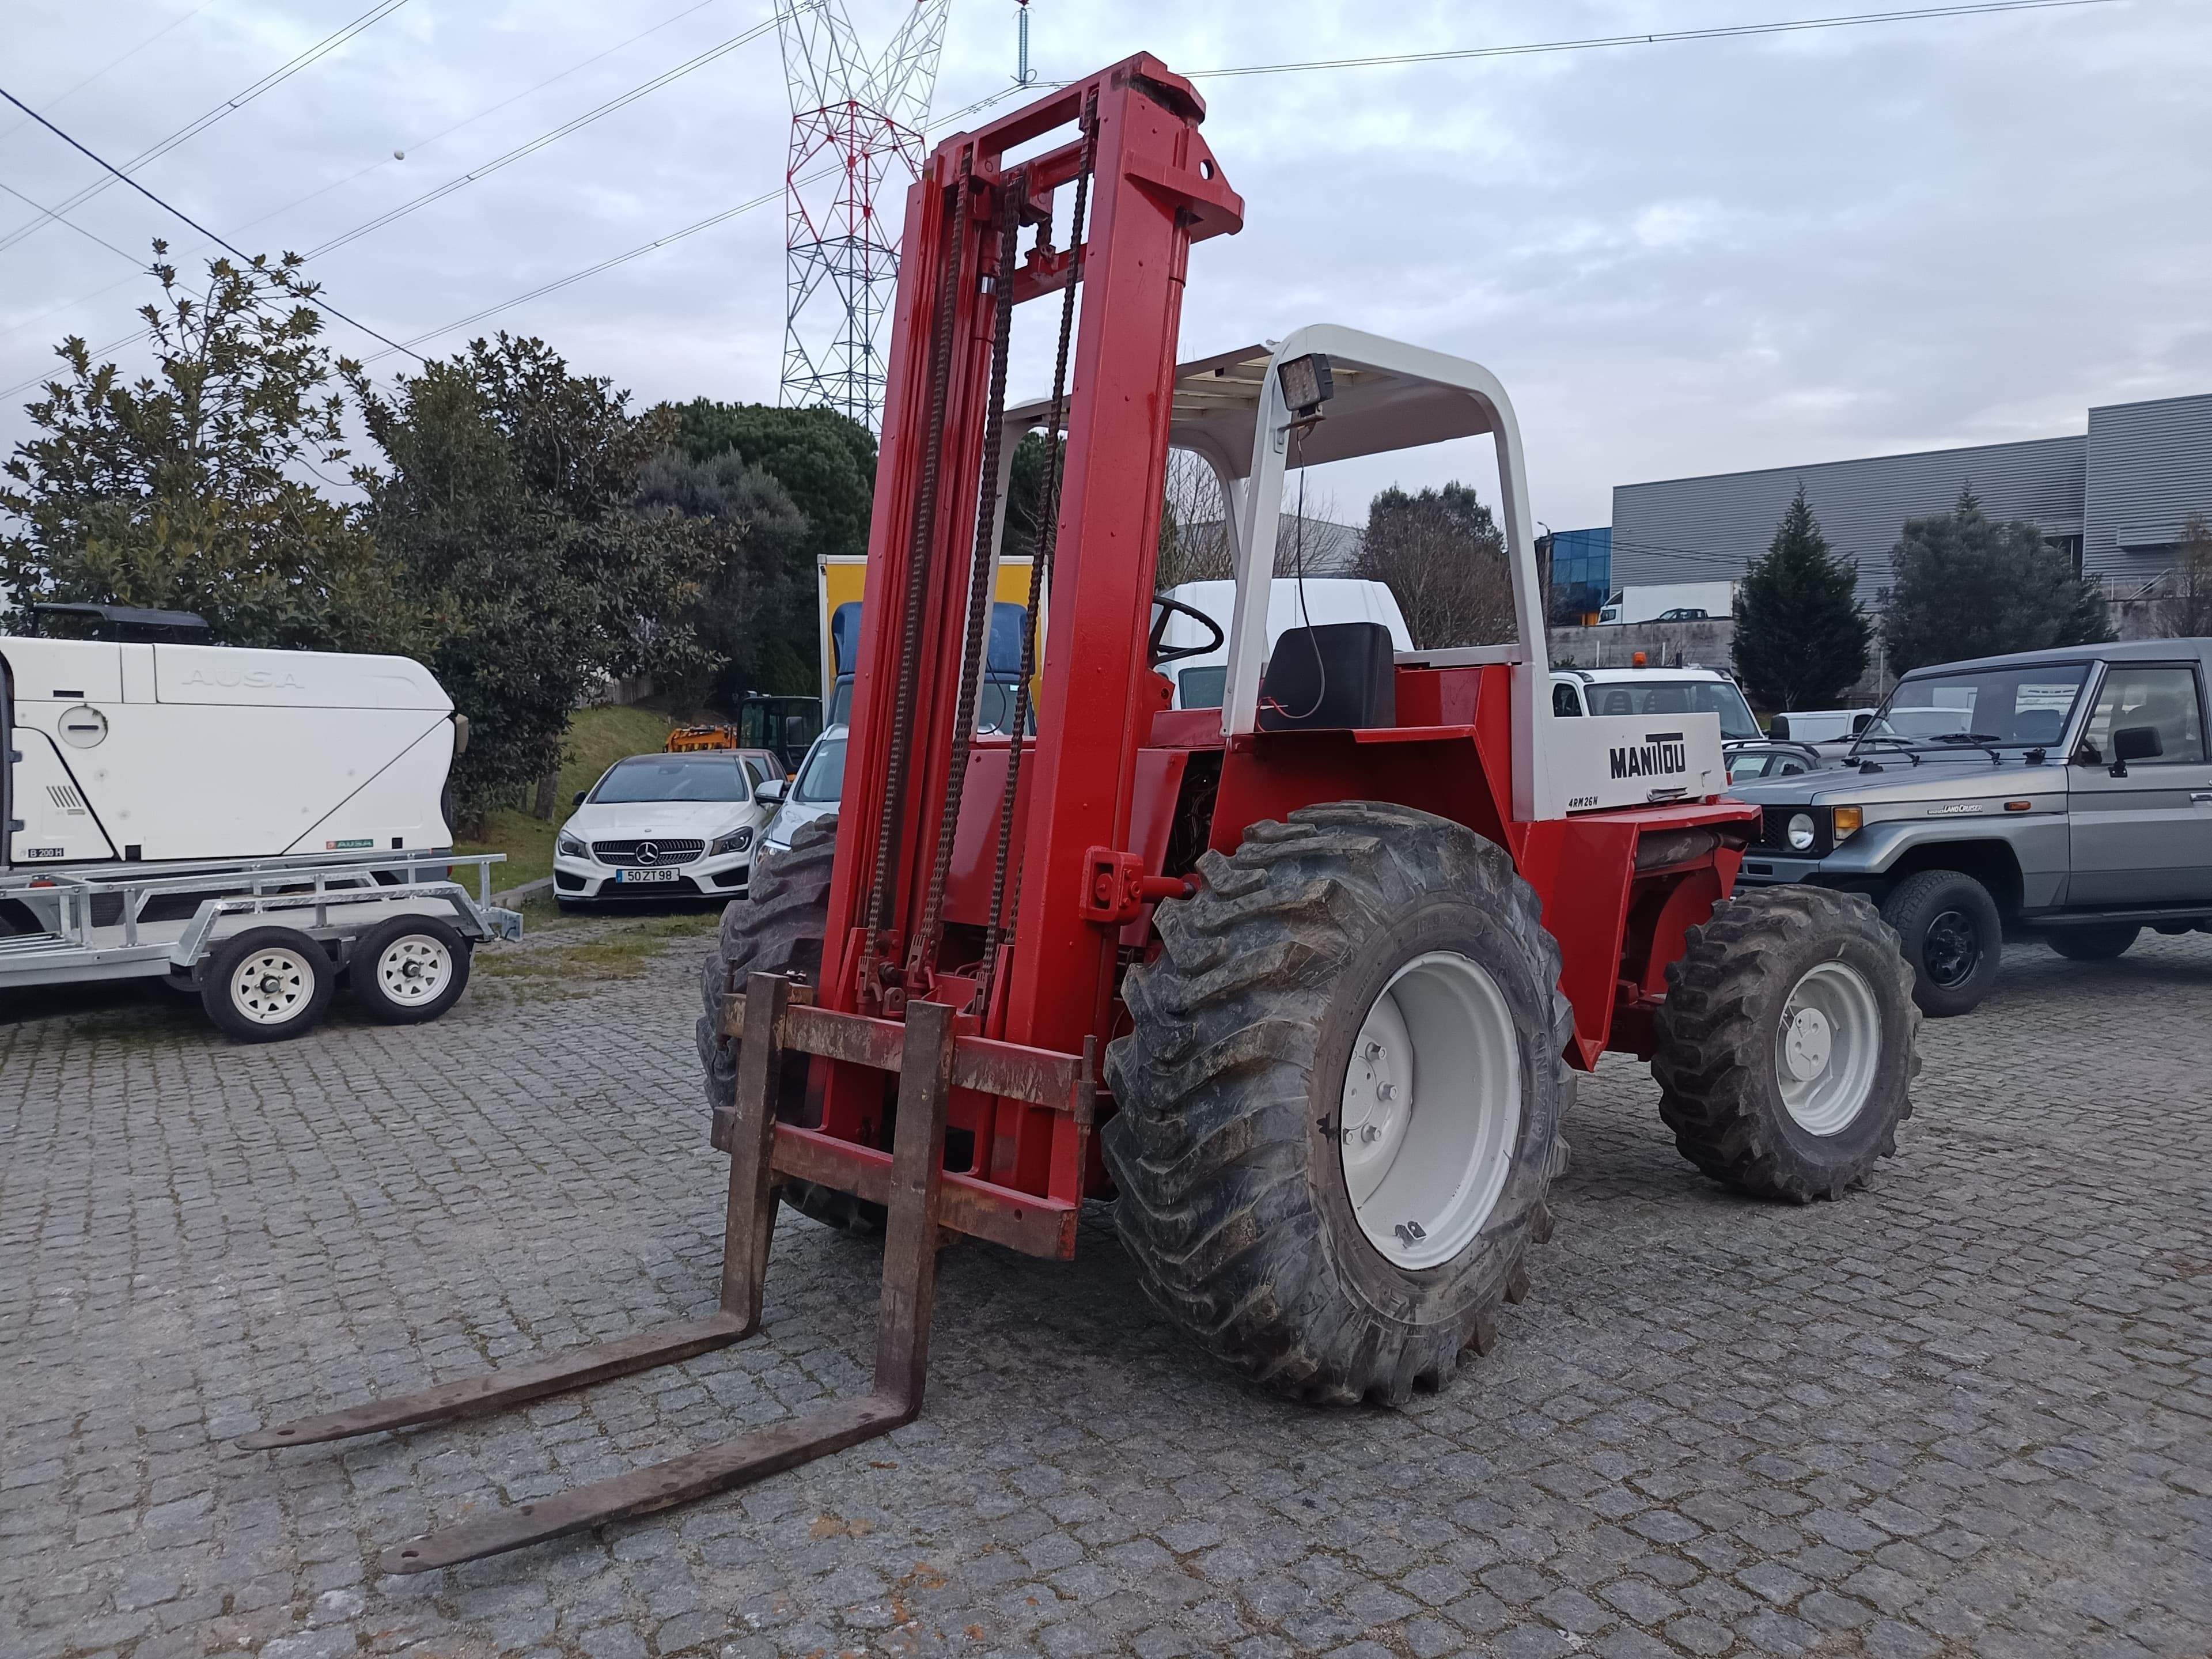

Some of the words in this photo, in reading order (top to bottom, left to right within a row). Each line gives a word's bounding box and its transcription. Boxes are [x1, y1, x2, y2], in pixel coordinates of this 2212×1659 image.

[180, 669, 306, 689] AUSA
[1609, 732, 1685, 779] MANITOU
[1944, 805, 1959, 813] LAND
[39, 849, 54, 857] 200
[55, 849, 62, 857] H
